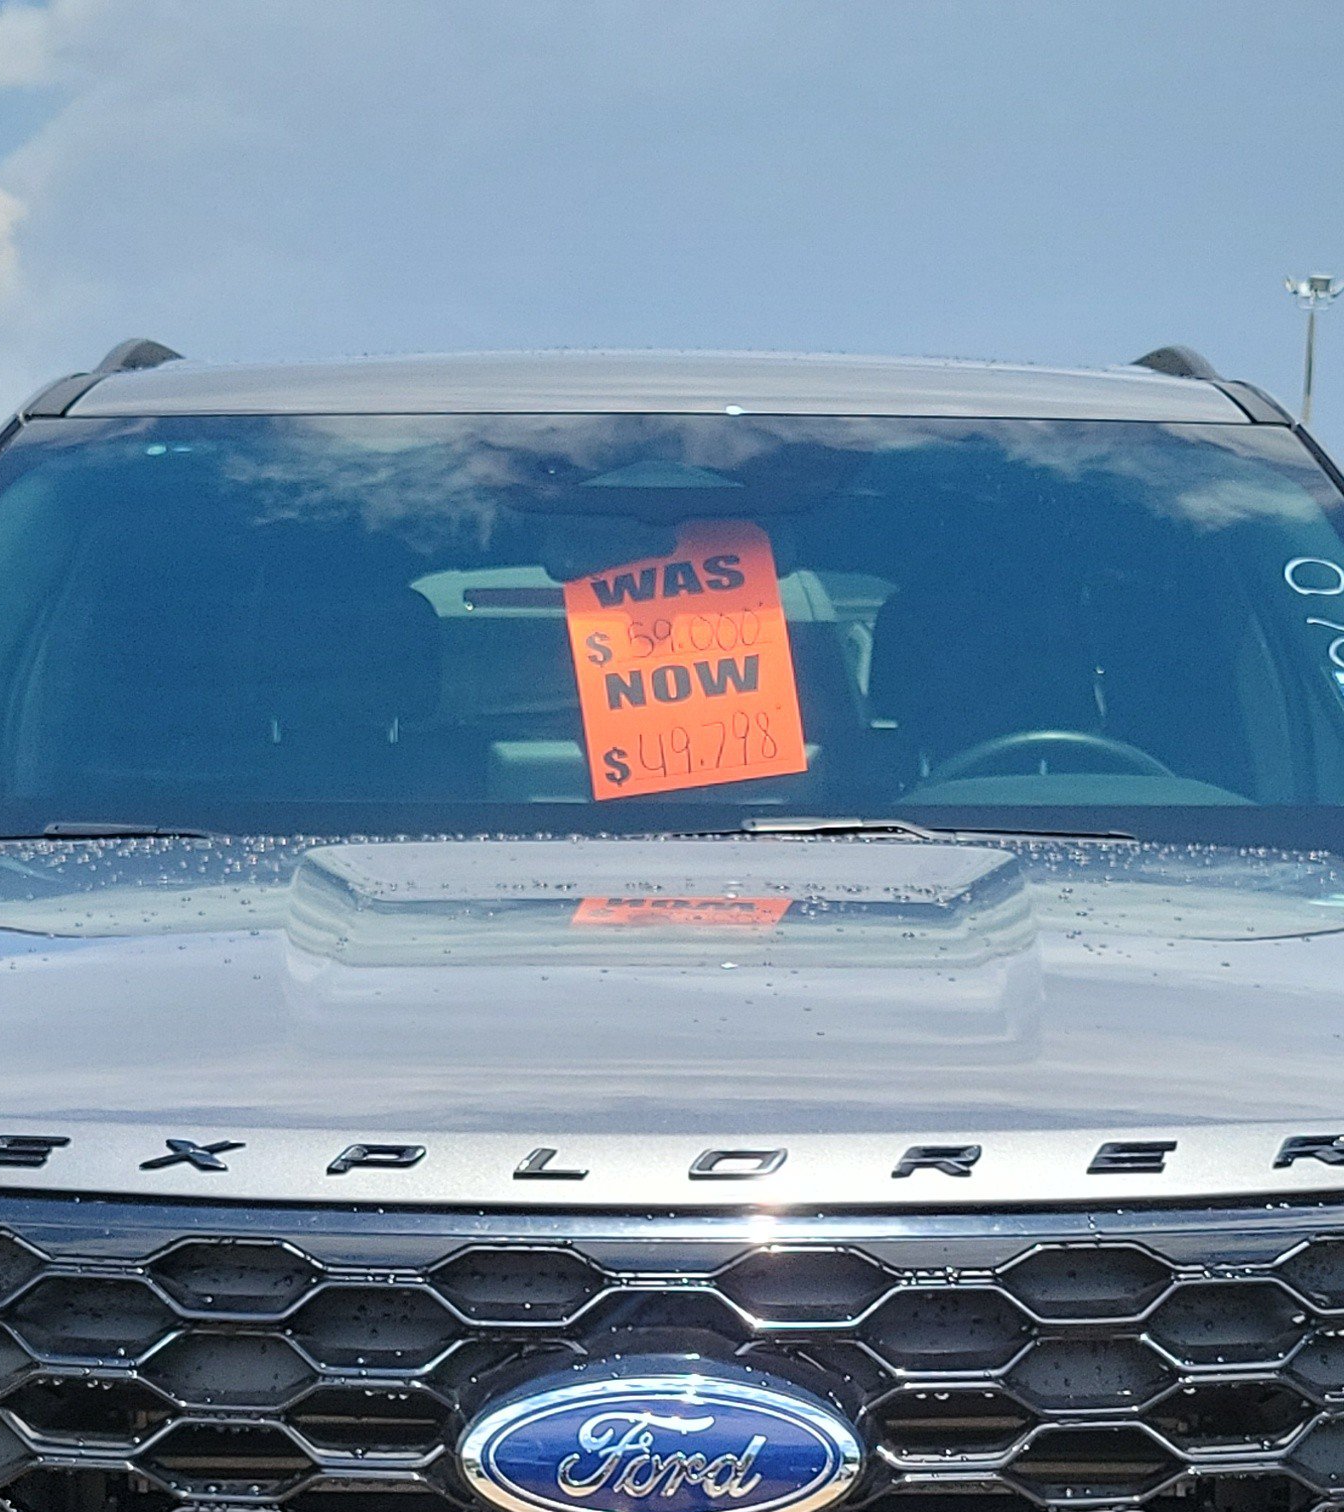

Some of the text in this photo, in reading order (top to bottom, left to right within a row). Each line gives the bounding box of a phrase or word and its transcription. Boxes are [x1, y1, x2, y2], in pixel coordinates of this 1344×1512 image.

[591, 554, 745, 608] WAS
[605, 654, 760, 711] NOW
[558, 1411, 767, 1498] Ford
